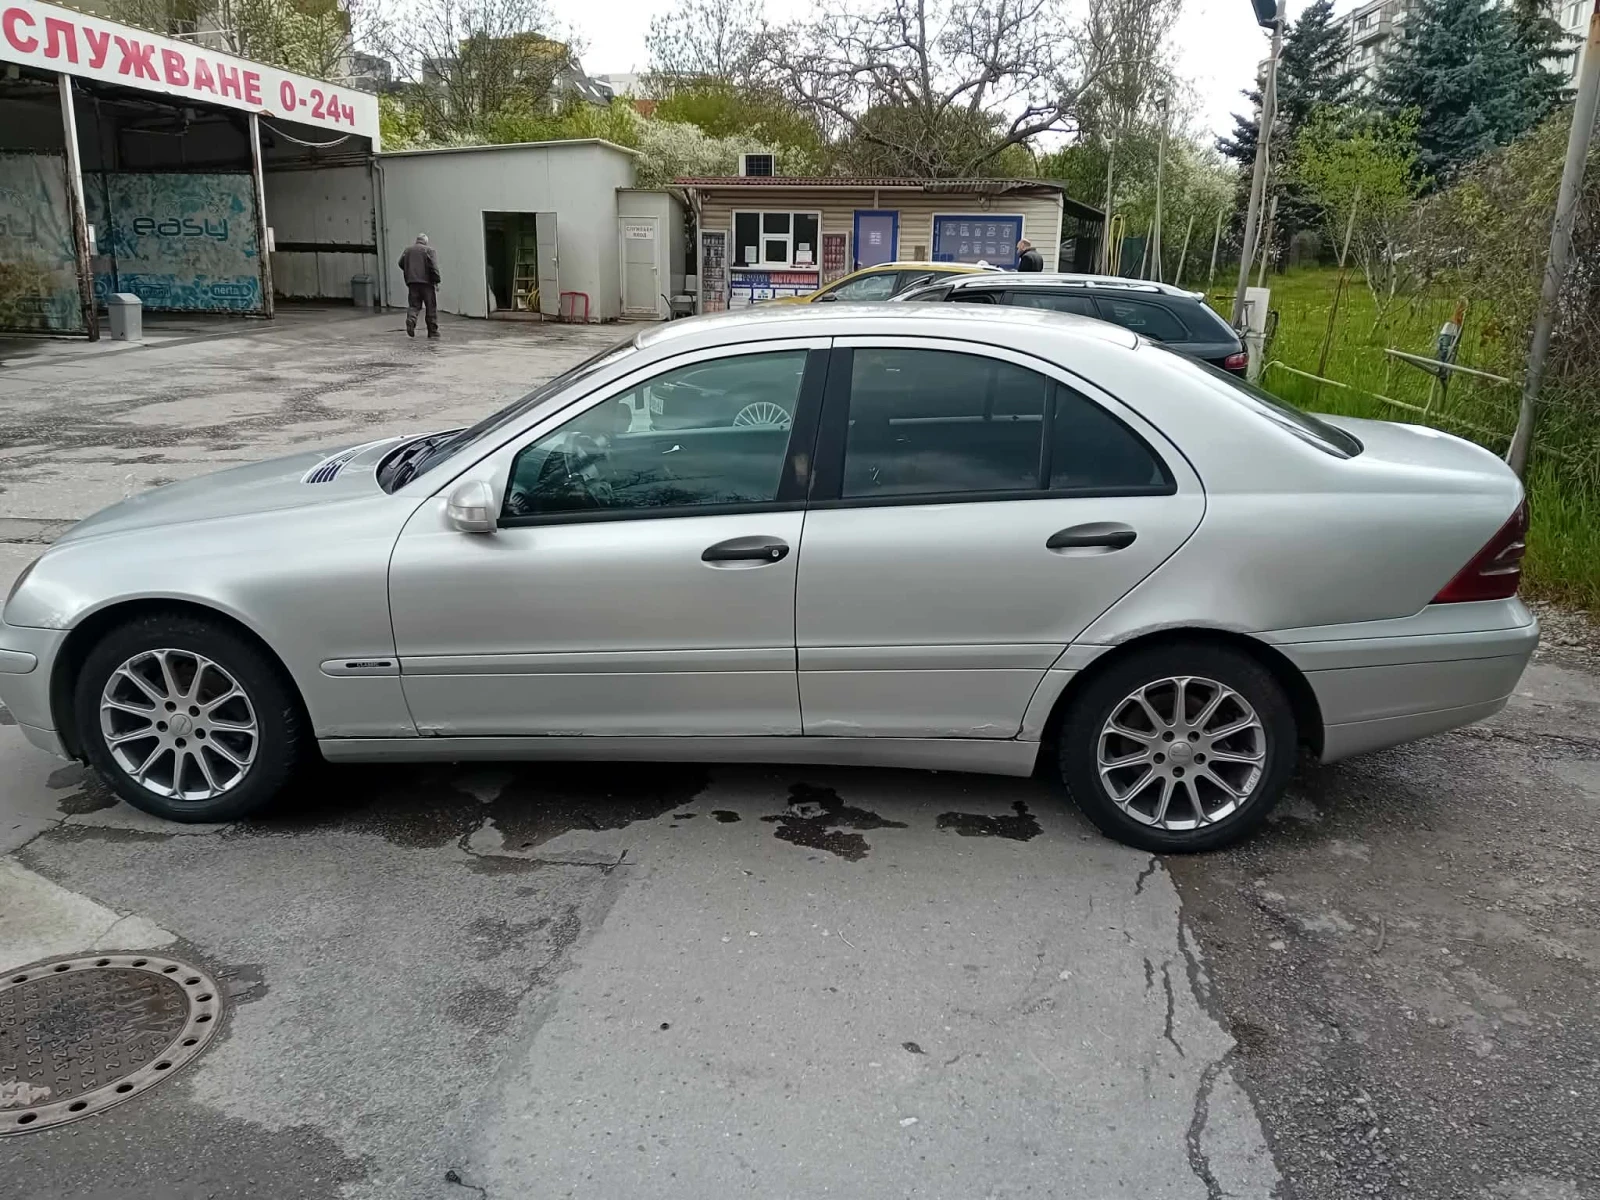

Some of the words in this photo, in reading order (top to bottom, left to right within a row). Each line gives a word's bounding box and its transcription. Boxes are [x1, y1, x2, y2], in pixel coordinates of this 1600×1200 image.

[2, 8, 263, 106] СЛУЖВАНЕ
[280, 80, 356, 127] 0-24ч
[132, 217, 229, 242] easy
[213, 284, 240, 295] nerta
